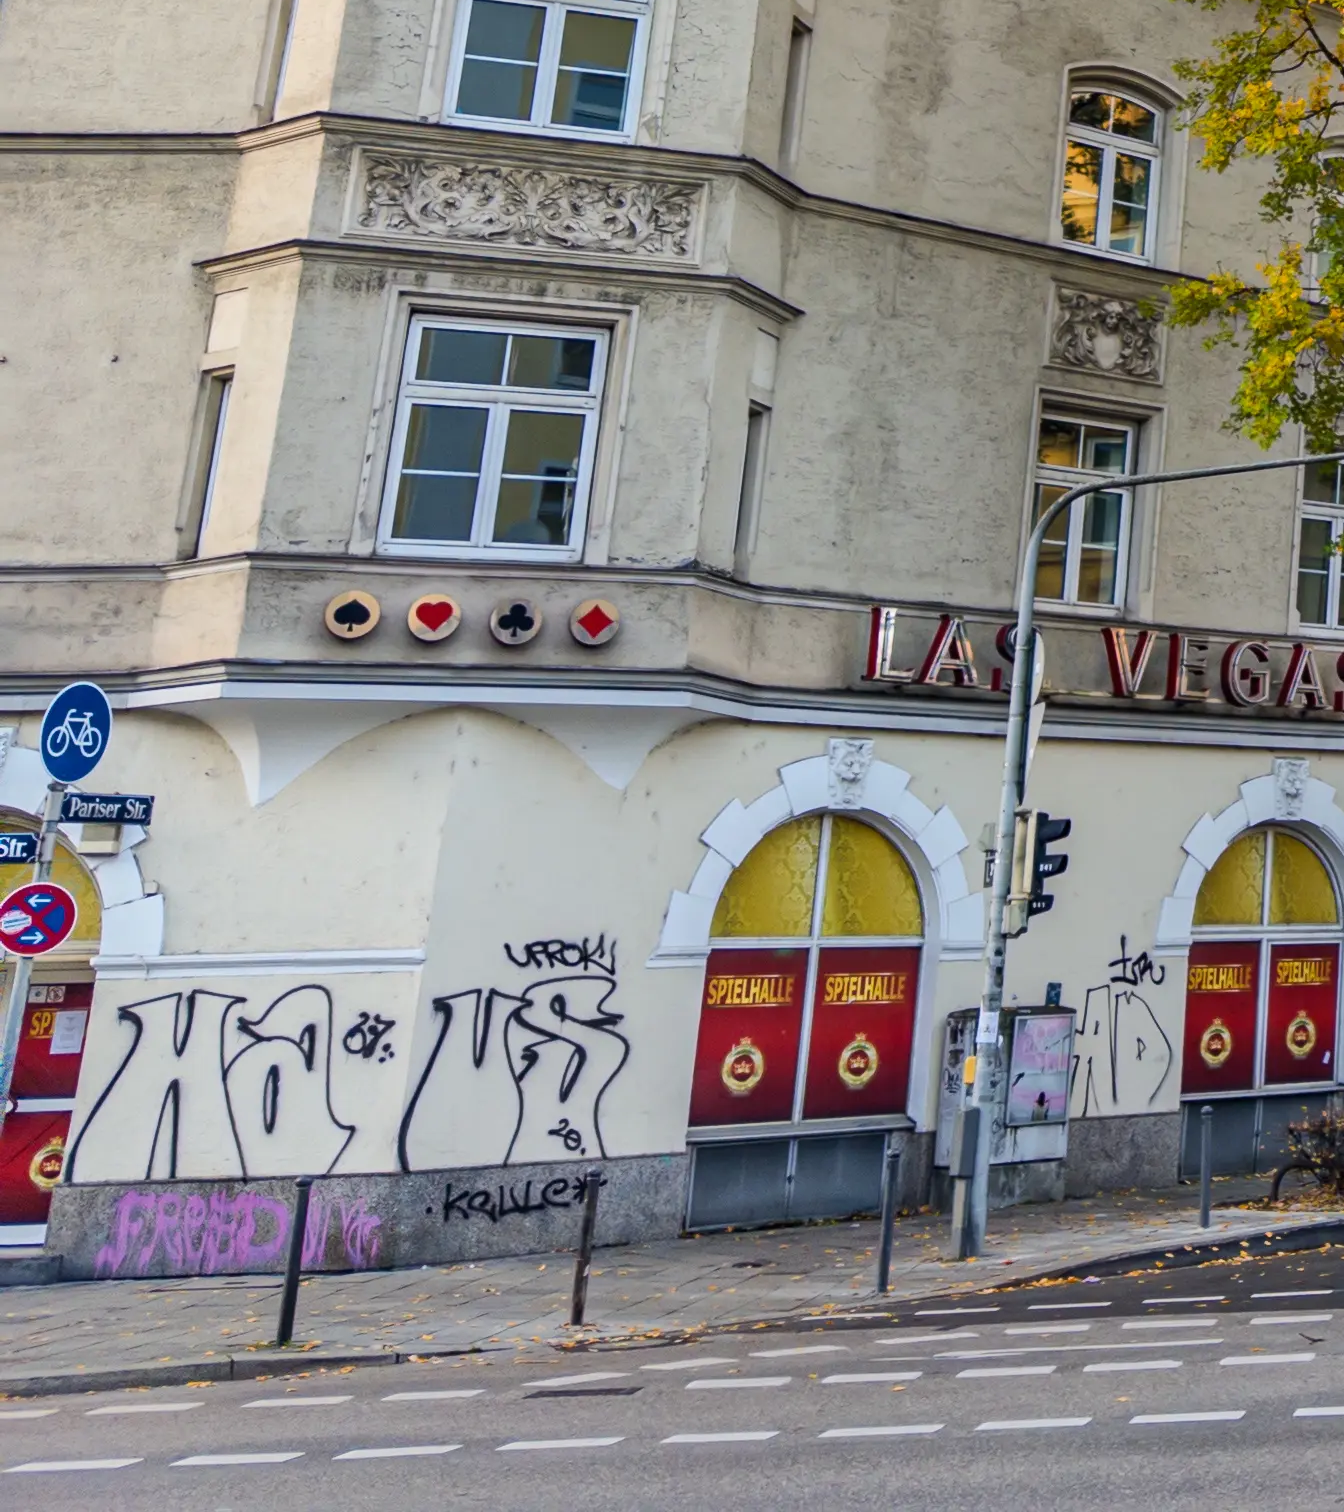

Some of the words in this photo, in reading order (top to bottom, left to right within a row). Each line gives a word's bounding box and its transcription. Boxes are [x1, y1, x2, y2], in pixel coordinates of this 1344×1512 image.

[69, 797, 121, 819] Pariser
[124, 798, 147, 820] Str.
[0, 837, 28, 858] Str.
[1188, 965, 1253, 991] SPIELHALLE
[1276, 959, 1333, 985] SPIELHALLE
[707, 976, 795, 1005] SPIELHALLE
[823, 975, 907, 1002] SPIELHALLE
